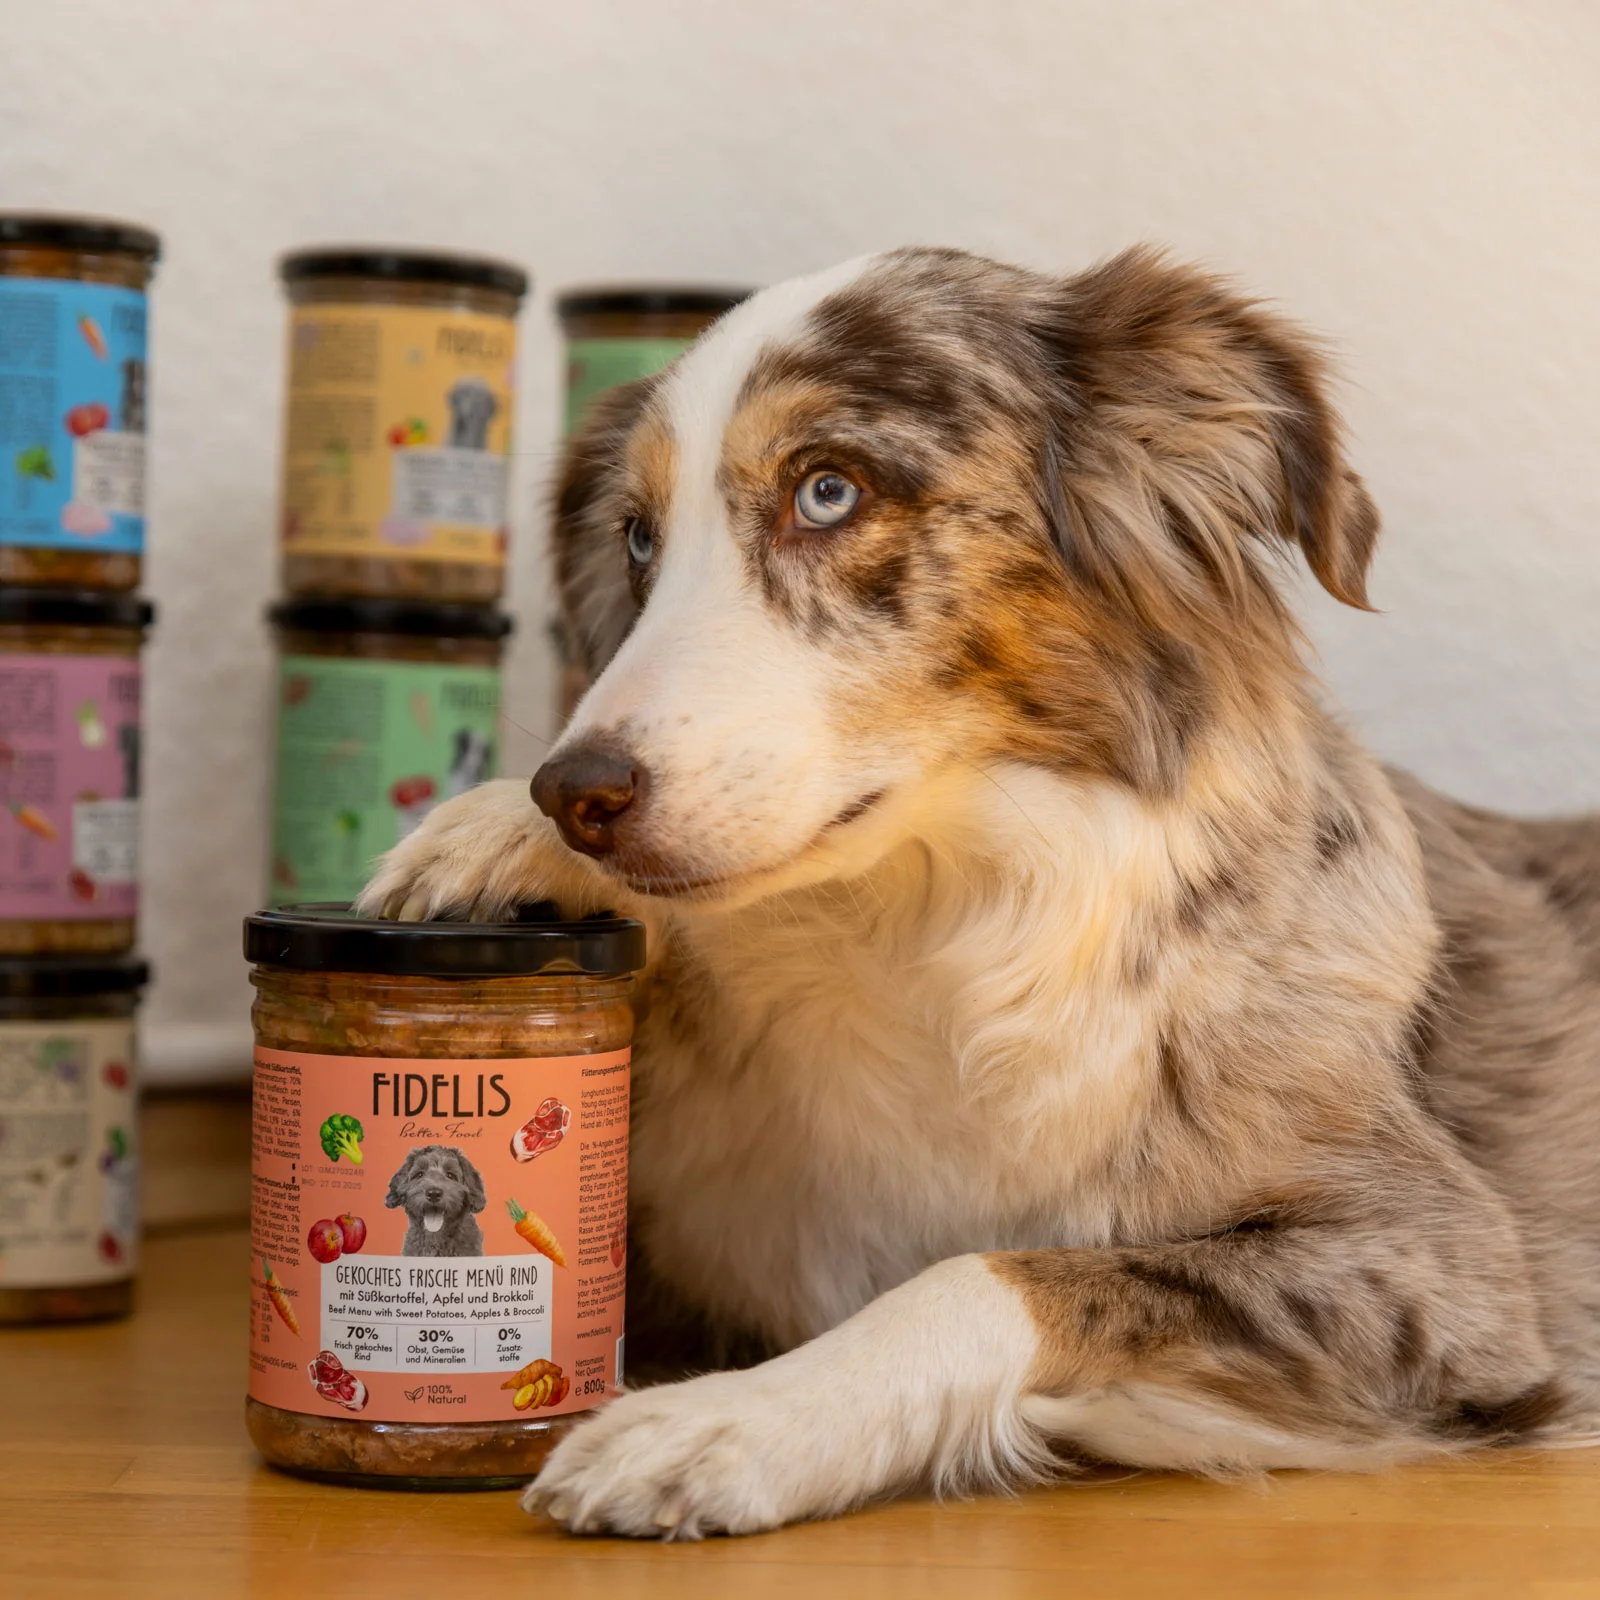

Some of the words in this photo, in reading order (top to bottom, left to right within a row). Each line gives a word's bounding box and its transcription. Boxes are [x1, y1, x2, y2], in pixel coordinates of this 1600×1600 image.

[373, 1072, 511, 1117] FIDELIS
[400, 1122, 441, 1138] Better
[445, 1122, 483, 1138] Food
[336, 1265, 402, 1287] GEKOCHTES
[409, 1268, 459, 1288] FRISCHE
[466, 1265, 504, 1288] MENÜ
[510, 1265, 538, 1286] RIND
[577, 1279, 588, 1287] The
[339, 1290, 354, 1301] mit
[357, 1290, 429, 1306] Süßkartoffel,
[432, 1291, 464, 1307] Apfel
[468, 1291, 488, 1304] und
[492, 1288, 534, 1303] Brokkoli
[577, 1290, 589, 1299] your
[577, 1300, 590, 1308] from
[328, 1304, 347, 1314] Beef
[348, 1306, 372, 1316] Menu
[374, 1307, 392, 1318] with
[396, 1308, 423, 1318] Sweet
[425, 1308, 467, 1320] Potatoes,
[470, 1308, 501, 1320] Apples
[503, 1307, 510, 1316] &
[513, 1305, 545, 1316] Broccoli
[346, 1326, 379, 1340] 70%
[418, 1329, 453, 1343] 30%
[498, 1327, 521, 1341] 0%
[334, 1339, 353, 1350] frisch
[355, 1342, 392, 1353] gekochtes
[407, 1345, 429, 1355] Obst,
[432, 1345, 465, 1354] Gemüse
[496, 1343, 523, 1353] Zusatz-
[354, 1352, 371, 1361] Rind
[405, 1355, 421, 1363] und
[423, 1354, 466, 1364] Mineralien
[499, 1352, 520, 1362] stoffe
[576, 1369, 585, 1377] Net
[427, 1385, 453, 1394] 100%
[584, 1378, 605, 1395] 800g
[428, 1395, 467, 1404] Natural
